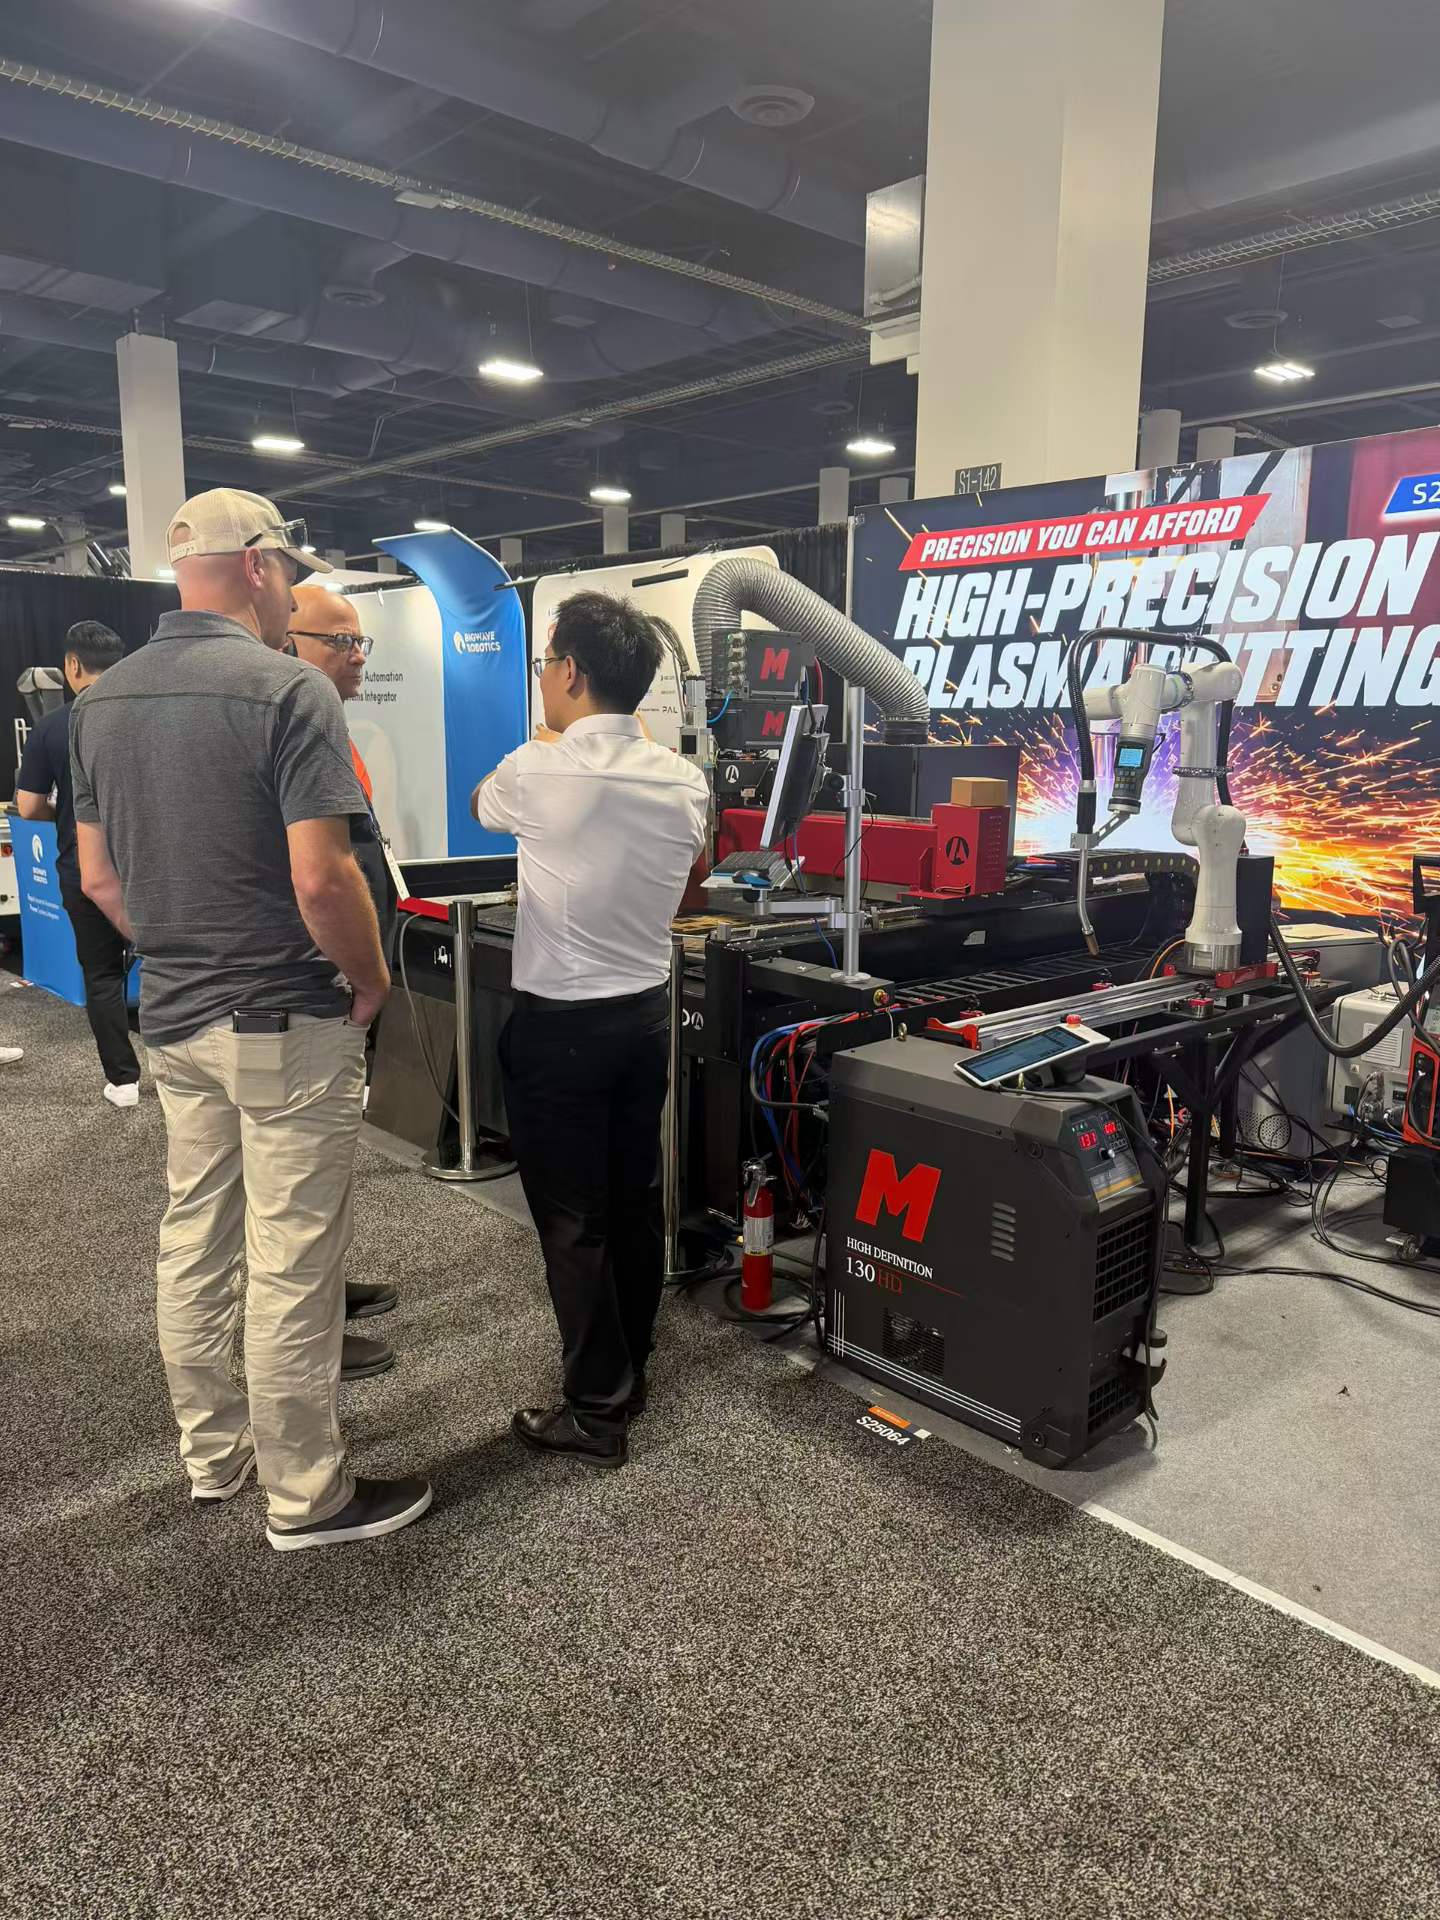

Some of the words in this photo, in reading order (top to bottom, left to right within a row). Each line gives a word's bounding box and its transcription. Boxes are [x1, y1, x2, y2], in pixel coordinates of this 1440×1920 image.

[958, 466, 997, 494] S1-142
[920, 532, 1032, 562] PRECISION
[1036, 524, 1081, 551] YOU
[1086, 515, 1141, 546] CAN
[1141, 505, 1243, 540] AFFORD
[894, 531, 1440, 639] HIGH-PRECISION
[365, 670, 404, 682] Automation
[760, 648, 790, 680] M
[365, 690, 397, 704] Integrator
[855, 1148, 942, 1243] M
[846, 1236, 872, 1256] HIGH
[873, 1246, 934, 1279] DEFINITION
[846, 1256, 876, 1282] 130
[877, 1266, 903, 1297] HD
[856, 1416, 911, 1446] S25064
